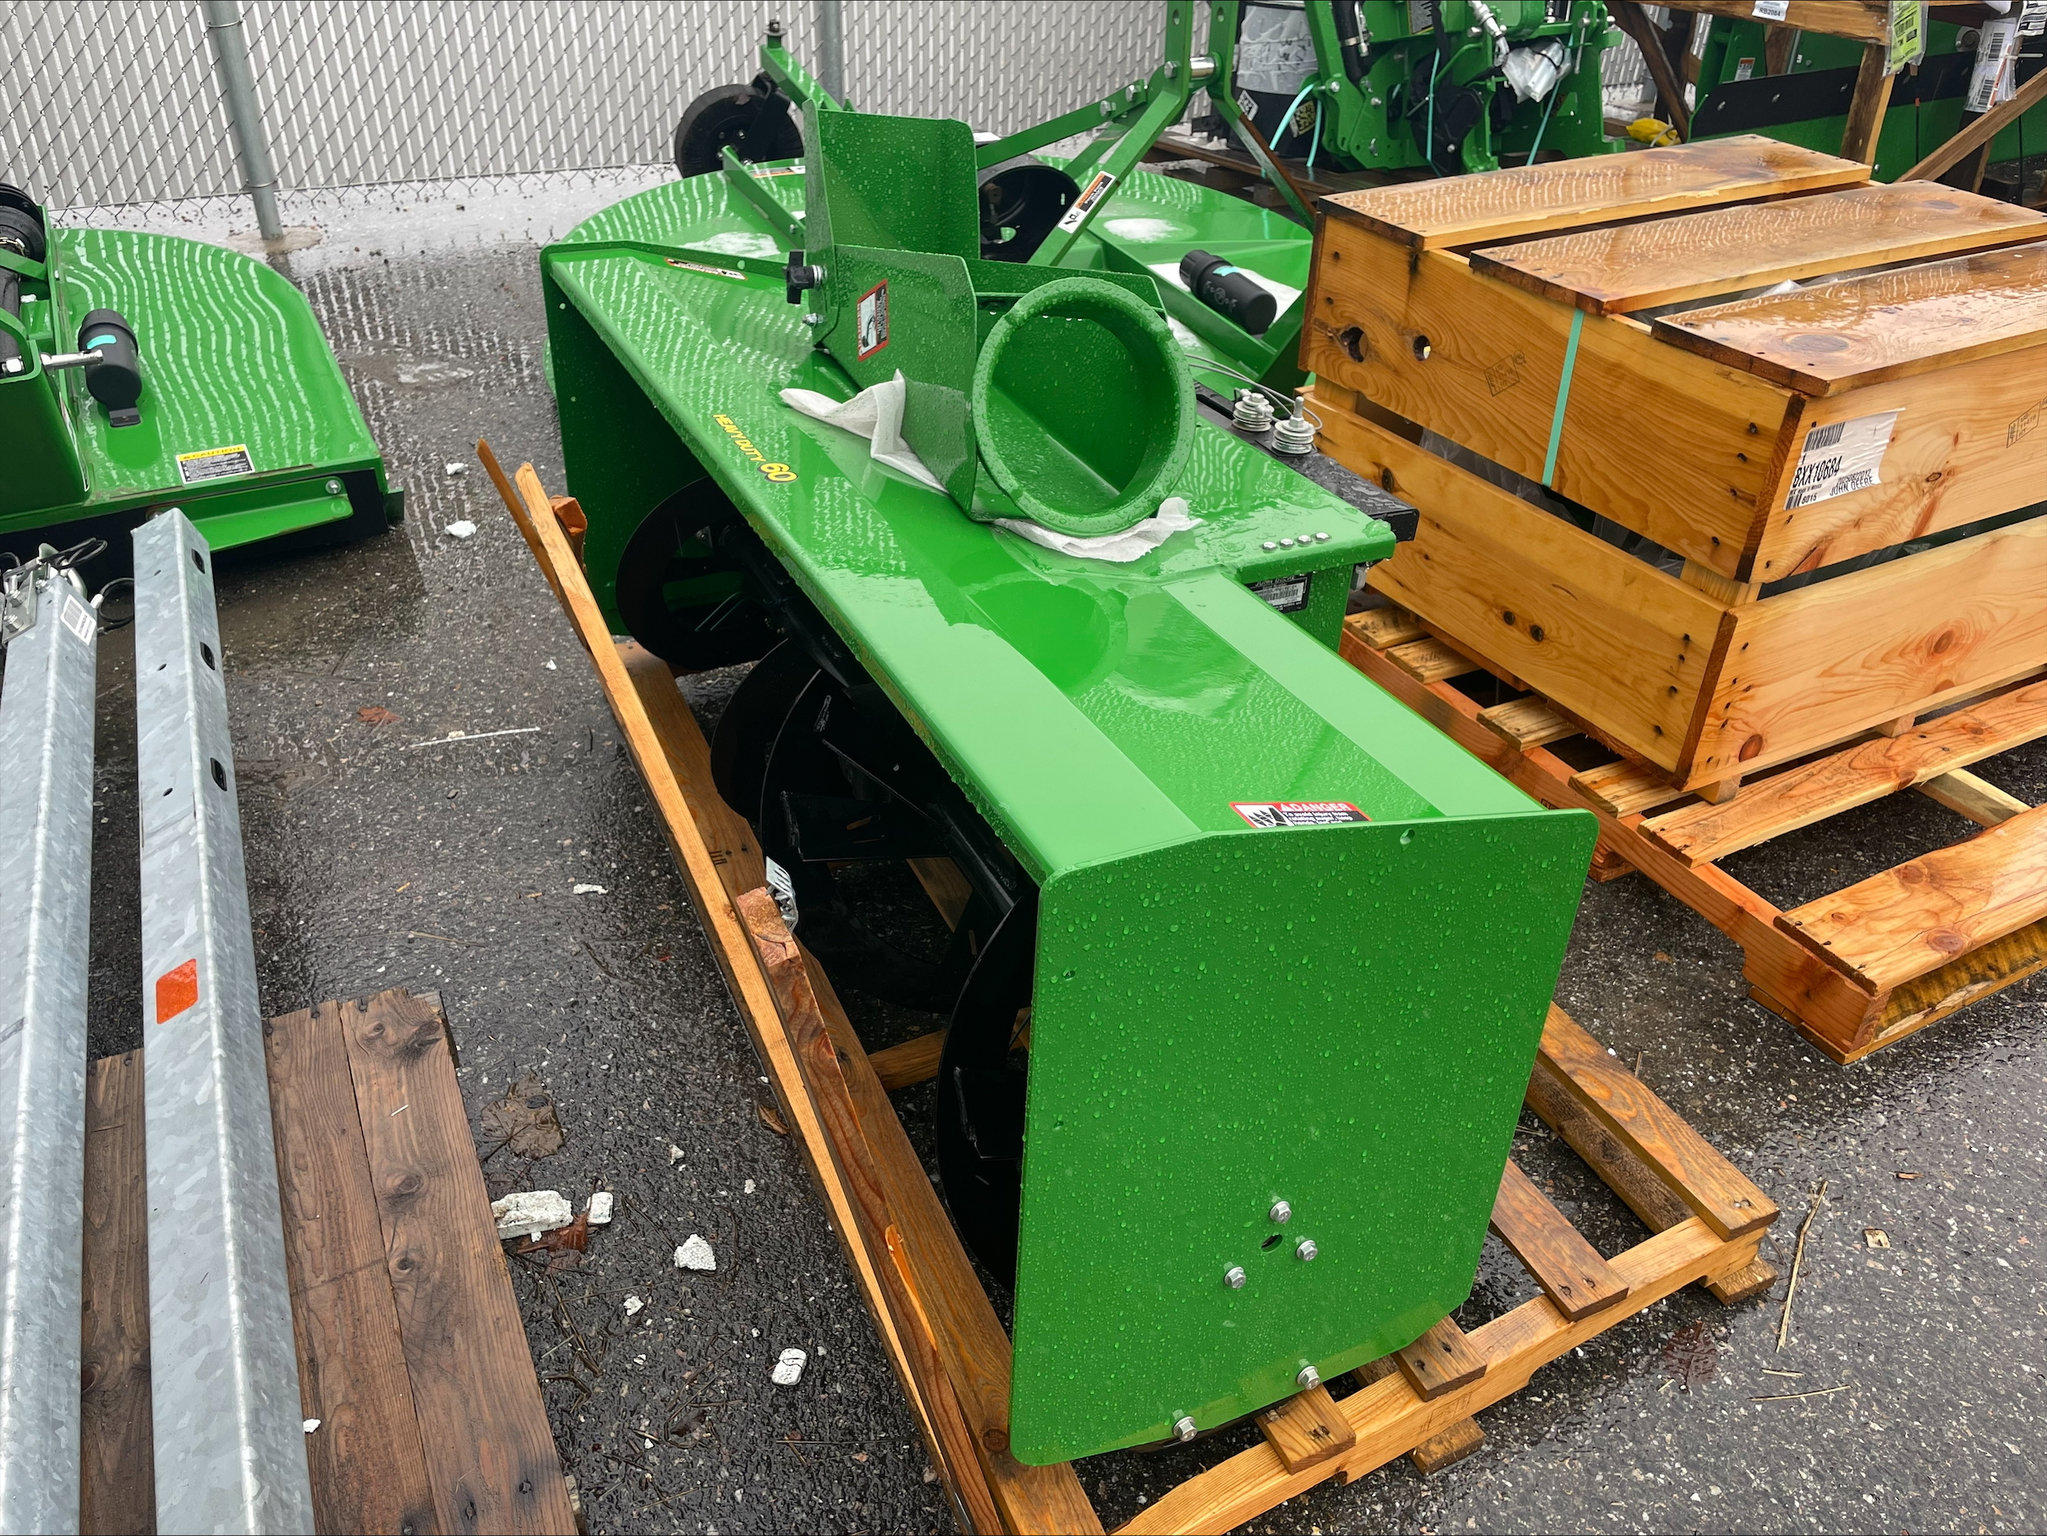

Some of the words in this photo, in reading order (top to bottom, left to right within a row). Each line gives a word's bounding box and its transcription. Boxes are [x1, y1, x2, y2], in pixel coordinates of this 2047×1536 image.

[757, 462, 798, 483] 60
[1829, 480, 1849, 496] JOHN
[1851, 475, 1875, 491] DEERE
[1289, 803, 1352, 811] DANGER
